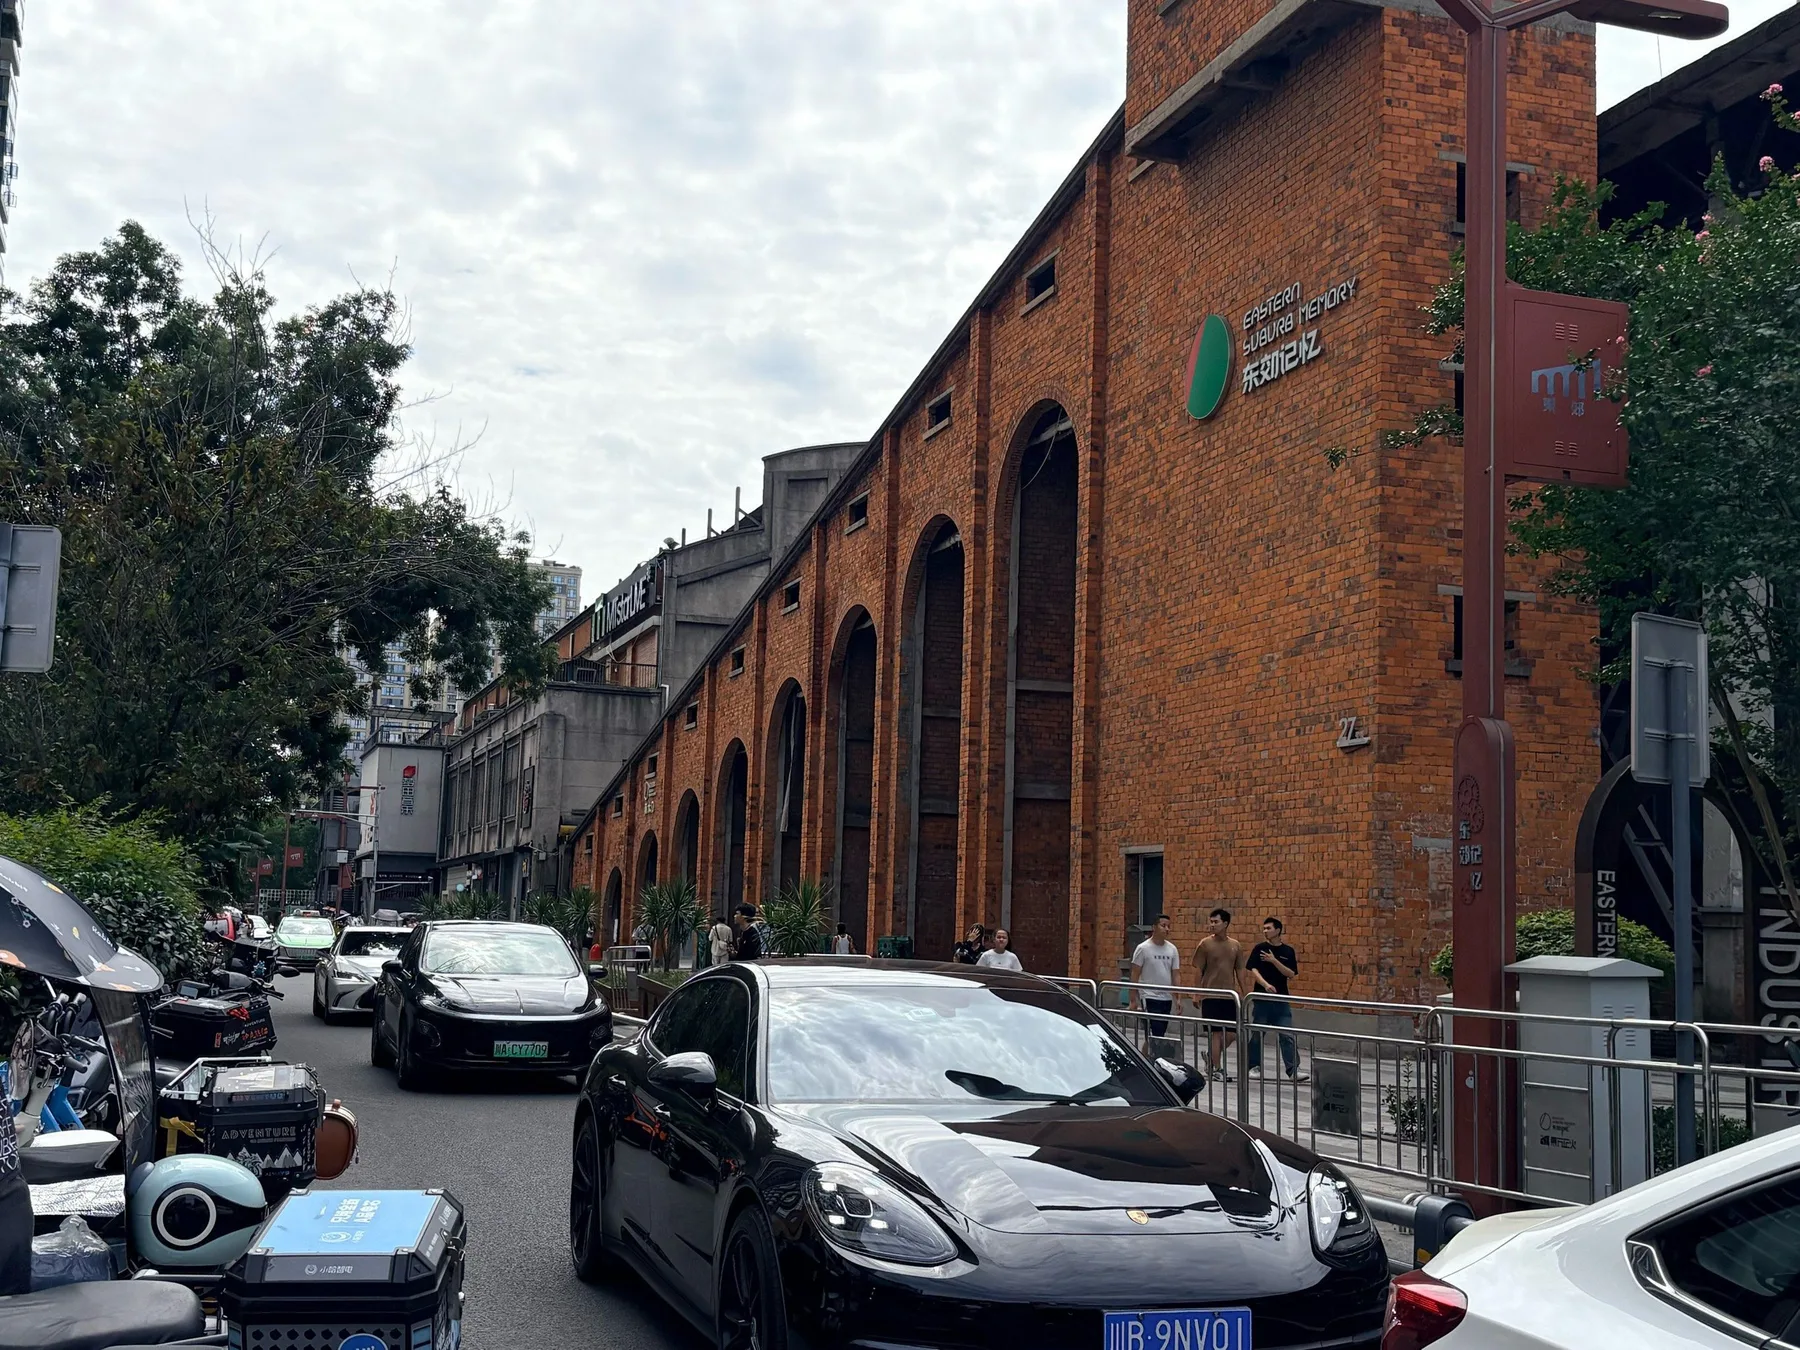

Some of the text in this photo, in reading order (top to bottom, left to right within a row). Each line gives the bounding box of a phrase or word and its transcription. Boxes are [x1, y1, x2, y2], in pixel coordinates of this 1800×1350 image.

[1242, 276, 1357, 357] SUBURB MEMORY
[1243, 281, 1301, 330] EASTERN
[1242, 328, 1322, 394] 东郊记忆
[221, 1126, 297, 1140] ADVENTURE
